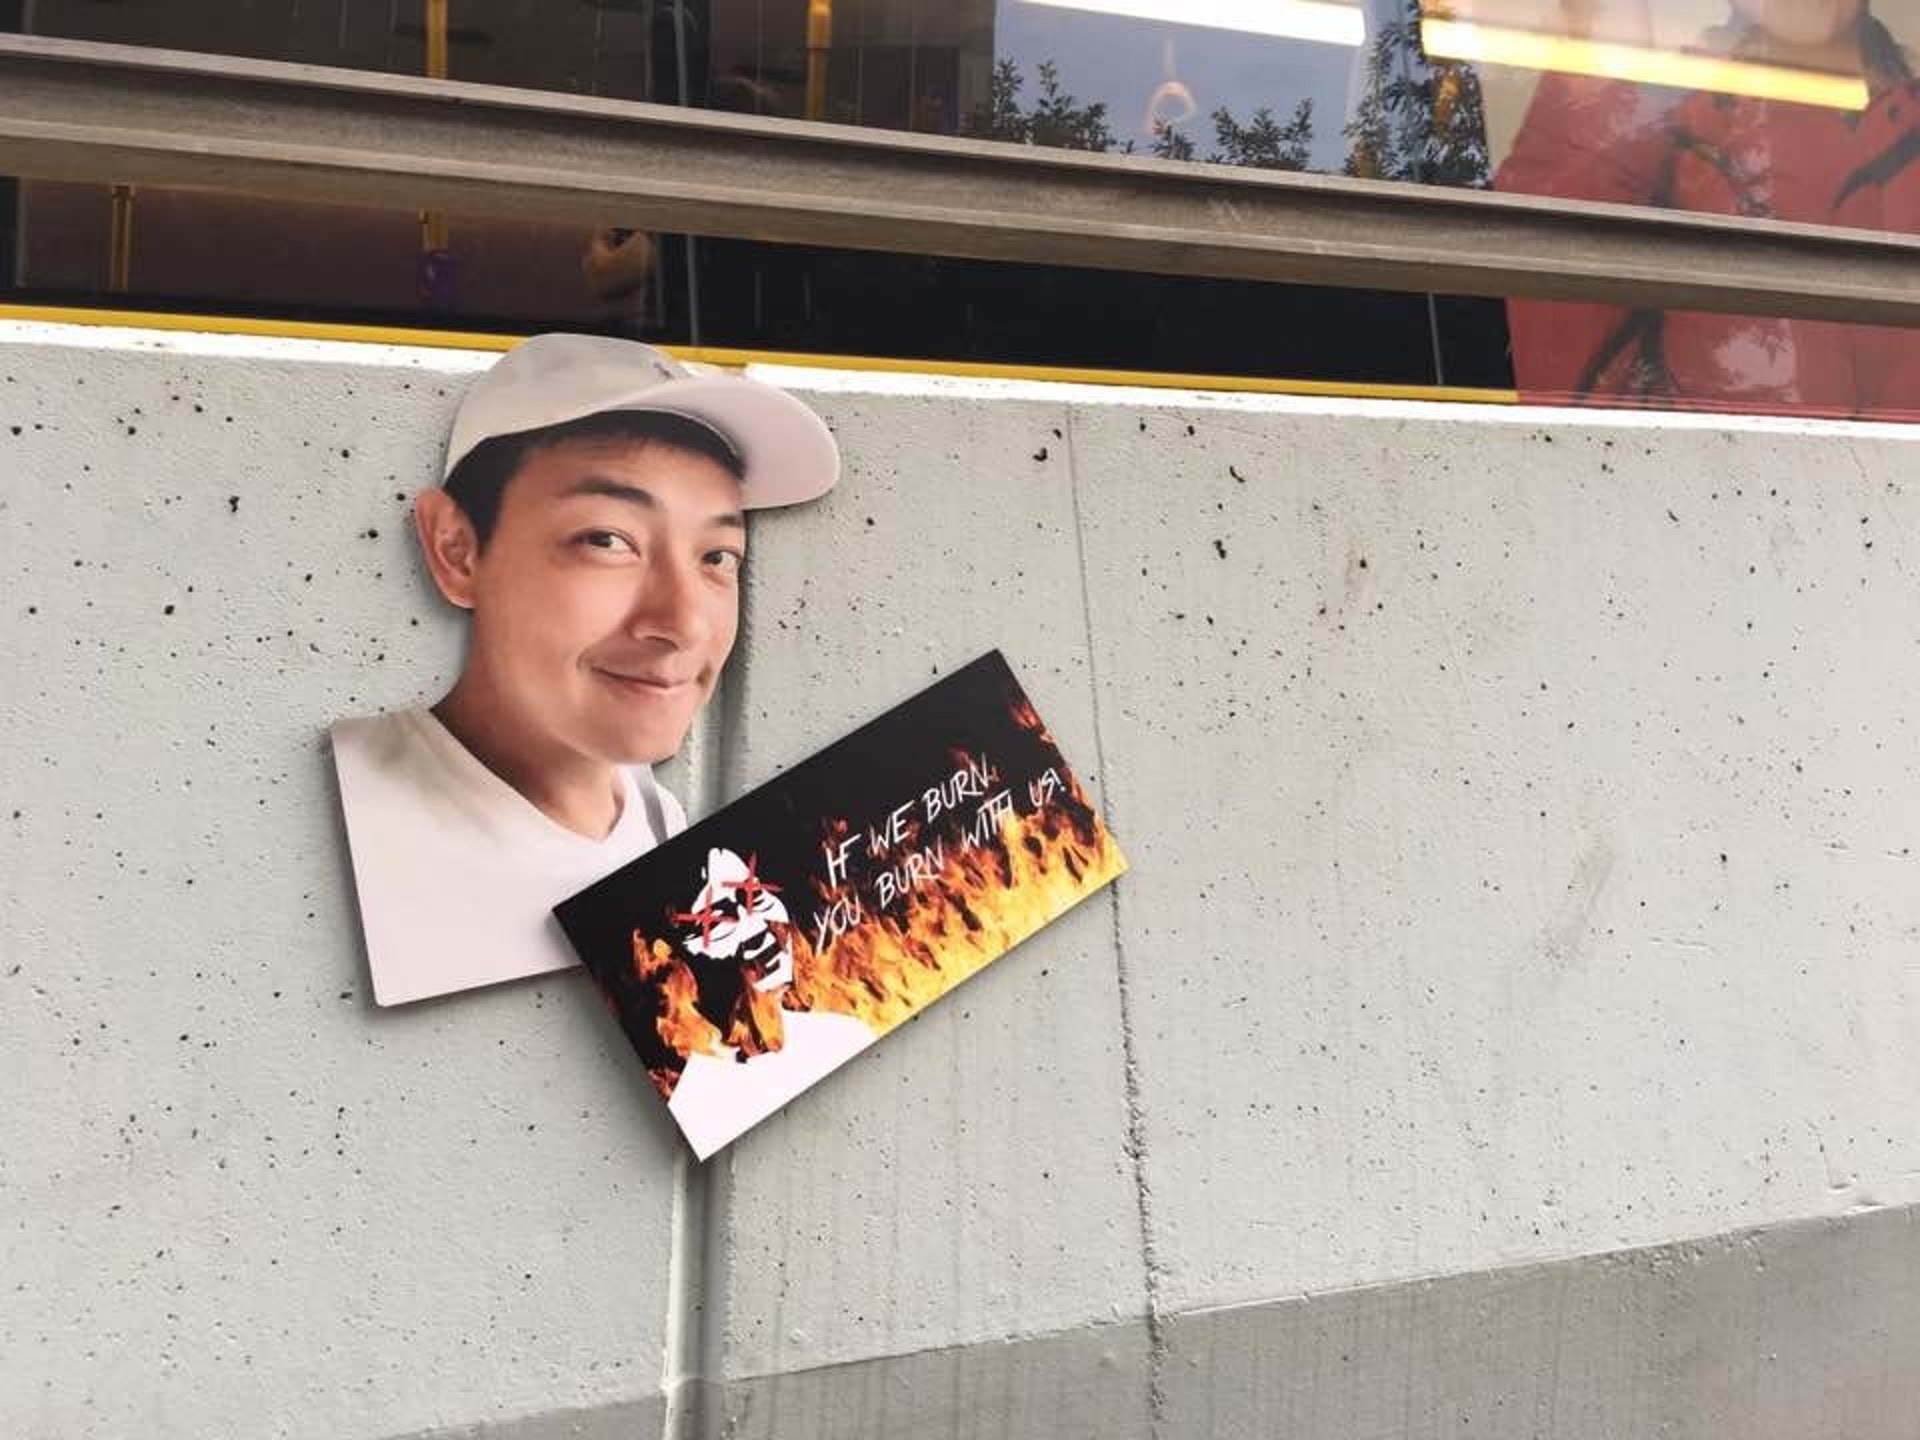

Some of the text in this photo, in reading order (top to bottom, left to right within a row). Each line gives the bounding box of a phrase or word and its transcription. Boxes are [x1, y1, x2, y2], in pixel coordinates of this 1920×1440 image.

[813, 767, 1067, 956] YOU BURN WITH US!
[825, 753, 989, 889] IF WE BURN
